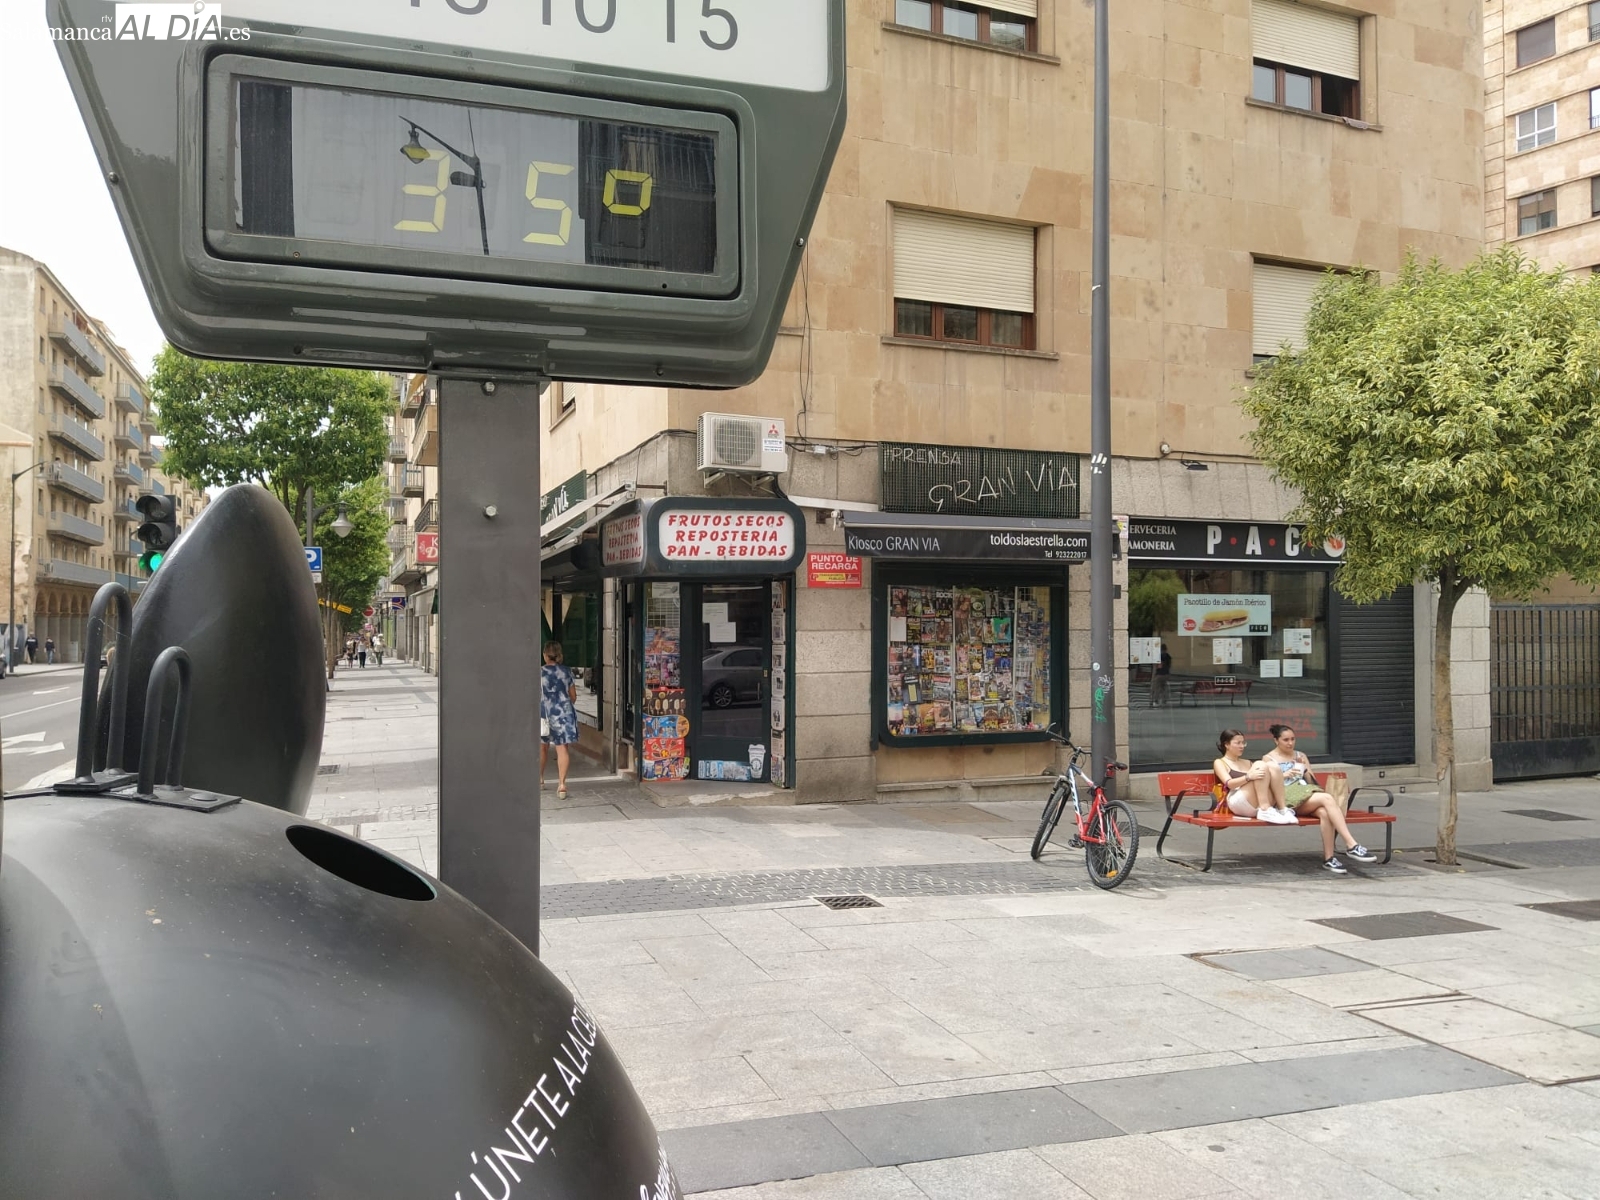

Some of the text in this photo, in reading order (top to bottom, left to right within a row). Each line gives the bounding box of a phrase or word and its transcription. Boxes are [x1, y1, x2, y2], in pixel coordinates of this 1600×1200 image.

[666, 0, 739, 50] 15
[890, 447, 962, 466] PRENSA
[928, 466, 1017, 513] GRAN
[668, 514, 785, 527] FRUTOS SECOS
[1129, 524, 1177, 535] ERVECERIA
[675, 530, 779, 542] REPOSTERIA
[848, 532, 1088, 551] Kiosco GRAN VIA toldoslaestrella.com
[667, 545, 701, 557] PAN
[716, 545, 788, 557] BEBIDAS
[1127, 540, 1176, 551] AMONERIA
[810, 554, 844, 562] PUNTO
[1044, 550, 1053, 558] Tel
[811, 562, 858, 570] RECARGA
[1212, 598, 1221, 606] de
